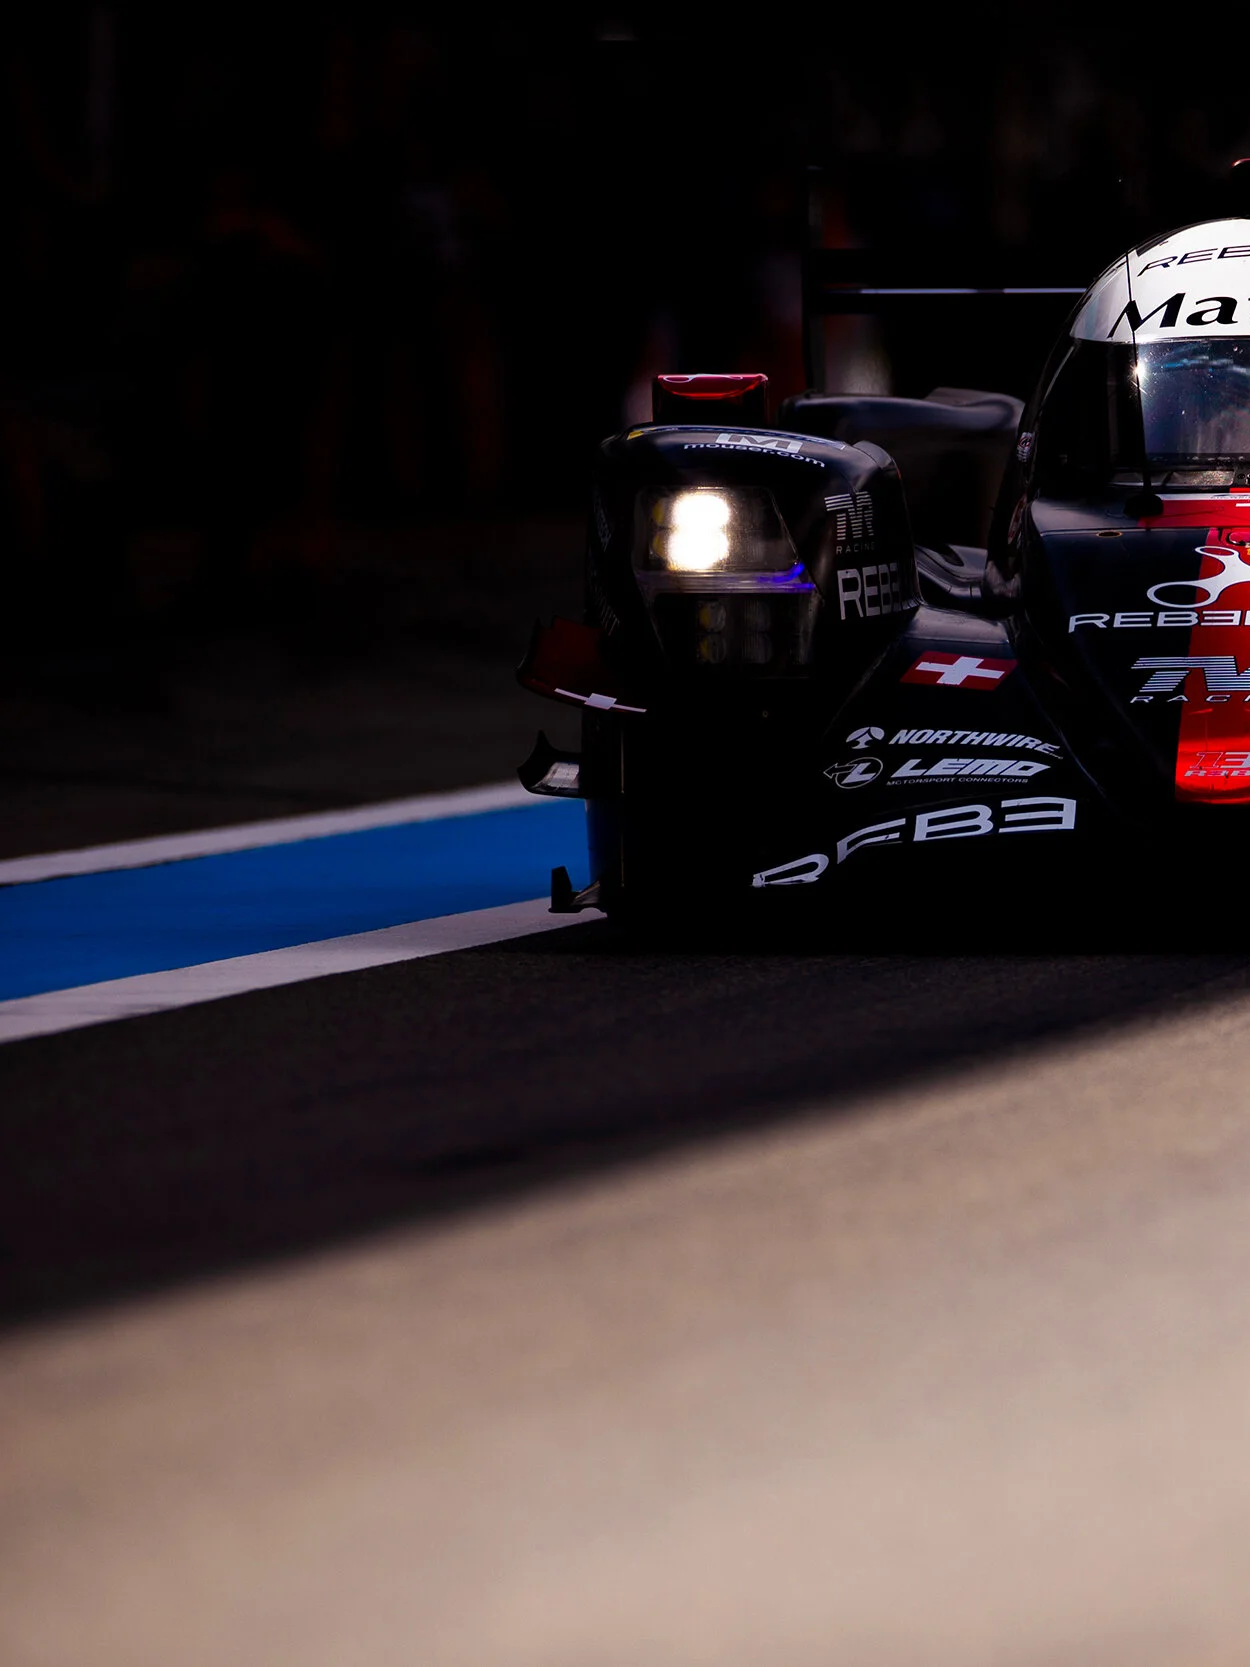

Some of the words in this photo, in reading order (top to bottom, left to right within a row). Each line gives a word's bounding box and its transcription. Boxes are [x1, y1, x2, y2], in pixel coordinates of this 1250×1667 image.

[683, 443, 825, 468] mouser.com
[888, 729, 1060, 754] NORTHWIRE
[890, 758, 1051, 778] LEMO
[886, 778, 955, 786] MOTORSPORT
